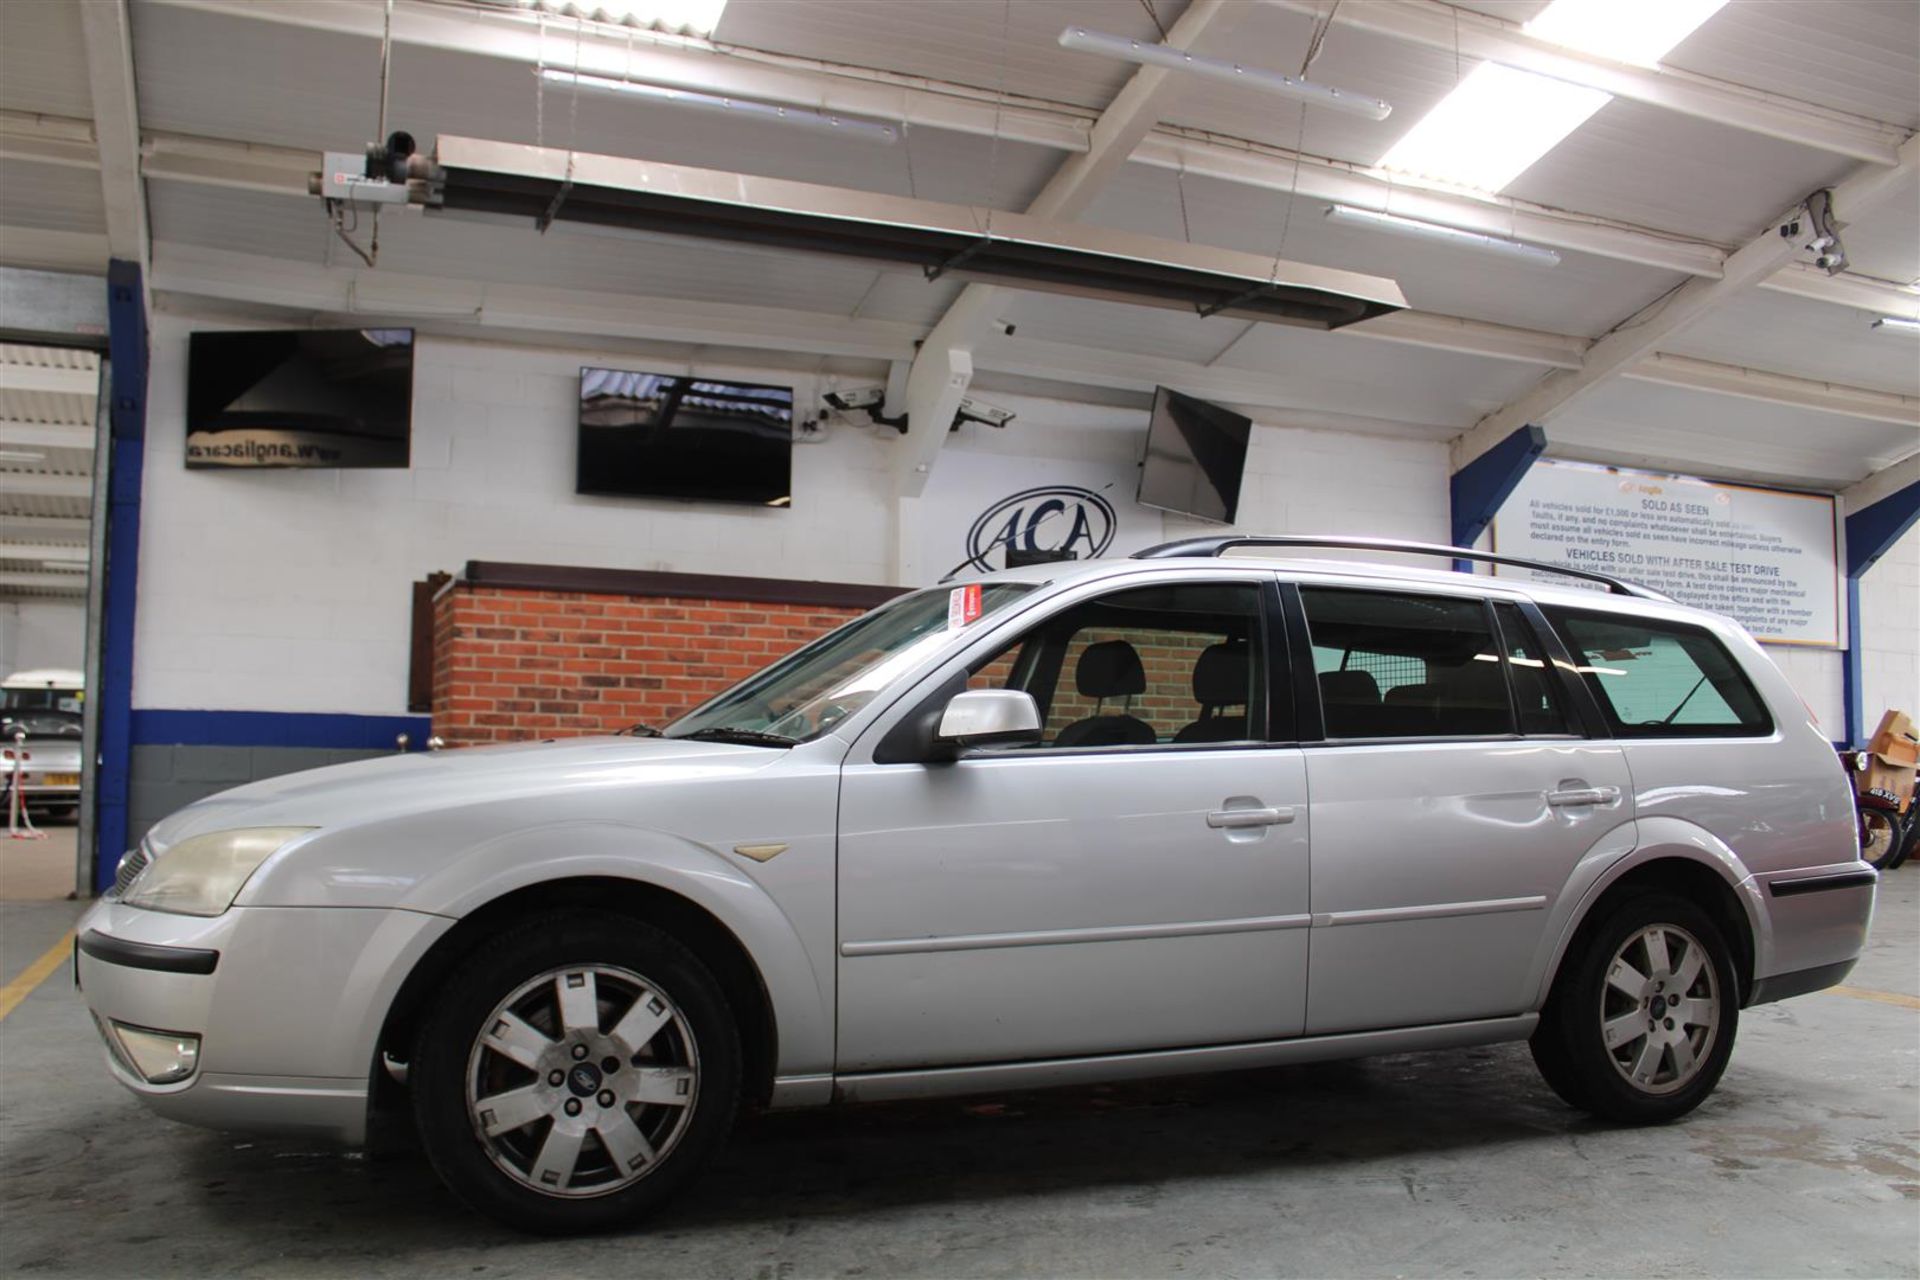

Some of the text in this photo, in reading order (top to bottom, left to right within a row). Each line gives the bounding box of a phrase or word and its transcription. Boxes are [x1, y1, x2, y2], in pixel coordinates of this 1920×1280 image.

[1530, 499, 1540, 508] All
[1542, 502, 1573, 512] vehicles
[1576, 504, 1591, 513] sold
[1593, 506, 1603, 514] for
[1640, 511, 1655, 520] less
[1670, 515, 1714, 528] automatically
[1641, 499, 1709, 515] SOLD AS SEEN
[982, 499, 1098, 558] ACA
[1582, 516, 1597, 524] and
[1609, 519, 1648, 530] complaints
[1650, 523, 1689, 533] whatsoever
[1691, 527, 1707, 535] shall
[1530, 522, 1549, 530] must
[1552, 523, 1580, 533] assume
[1583, 525, 1591, 534] all
[1594, 527, 1625, 537] vehicles
[1626, 530, 1641, 539] sold
[1653, 533, 1669, 541] seen
[1671, 534, 1687, 543] have
[1689, 536, 1719, 546] incorrect
[1721, 540, 1747, 551] mileage
[1749, 543, 1769, 552] unless
[1771, 544, 1802, 554] otherwise
[1530, 530, 1563, 542] declared
[1577, 535, 1589, 543] the
[1591, 537, 1610, 547] entry
[1566, 549, 1780, 577] VEHICLES SOLD WITH AFTER SALE TEST DRIVE
[1582, 562, 1599, 571] sold
[1698, 572, 1711, 581] this
[1713, 574, 1729, 582] shall
[1731, 575, 1739, 583] be
[1741, 577, 1776, 587] announced
[1778, 579, 1785, 589] by
[1787, 580, 1797, 588] the
[1677, 590, 1710, 601] displayed
[1719, 593, 1729, 602] the
[1731, 595, 1750, 604] office
[1752, 596, 1764, 605] and
[1780, 598, 1791, 607] the
[1708, 583, 1724, 592] drive
[1726, 585, 1748, 594] covers
[1770, 588, 1806, 598] mechanical
